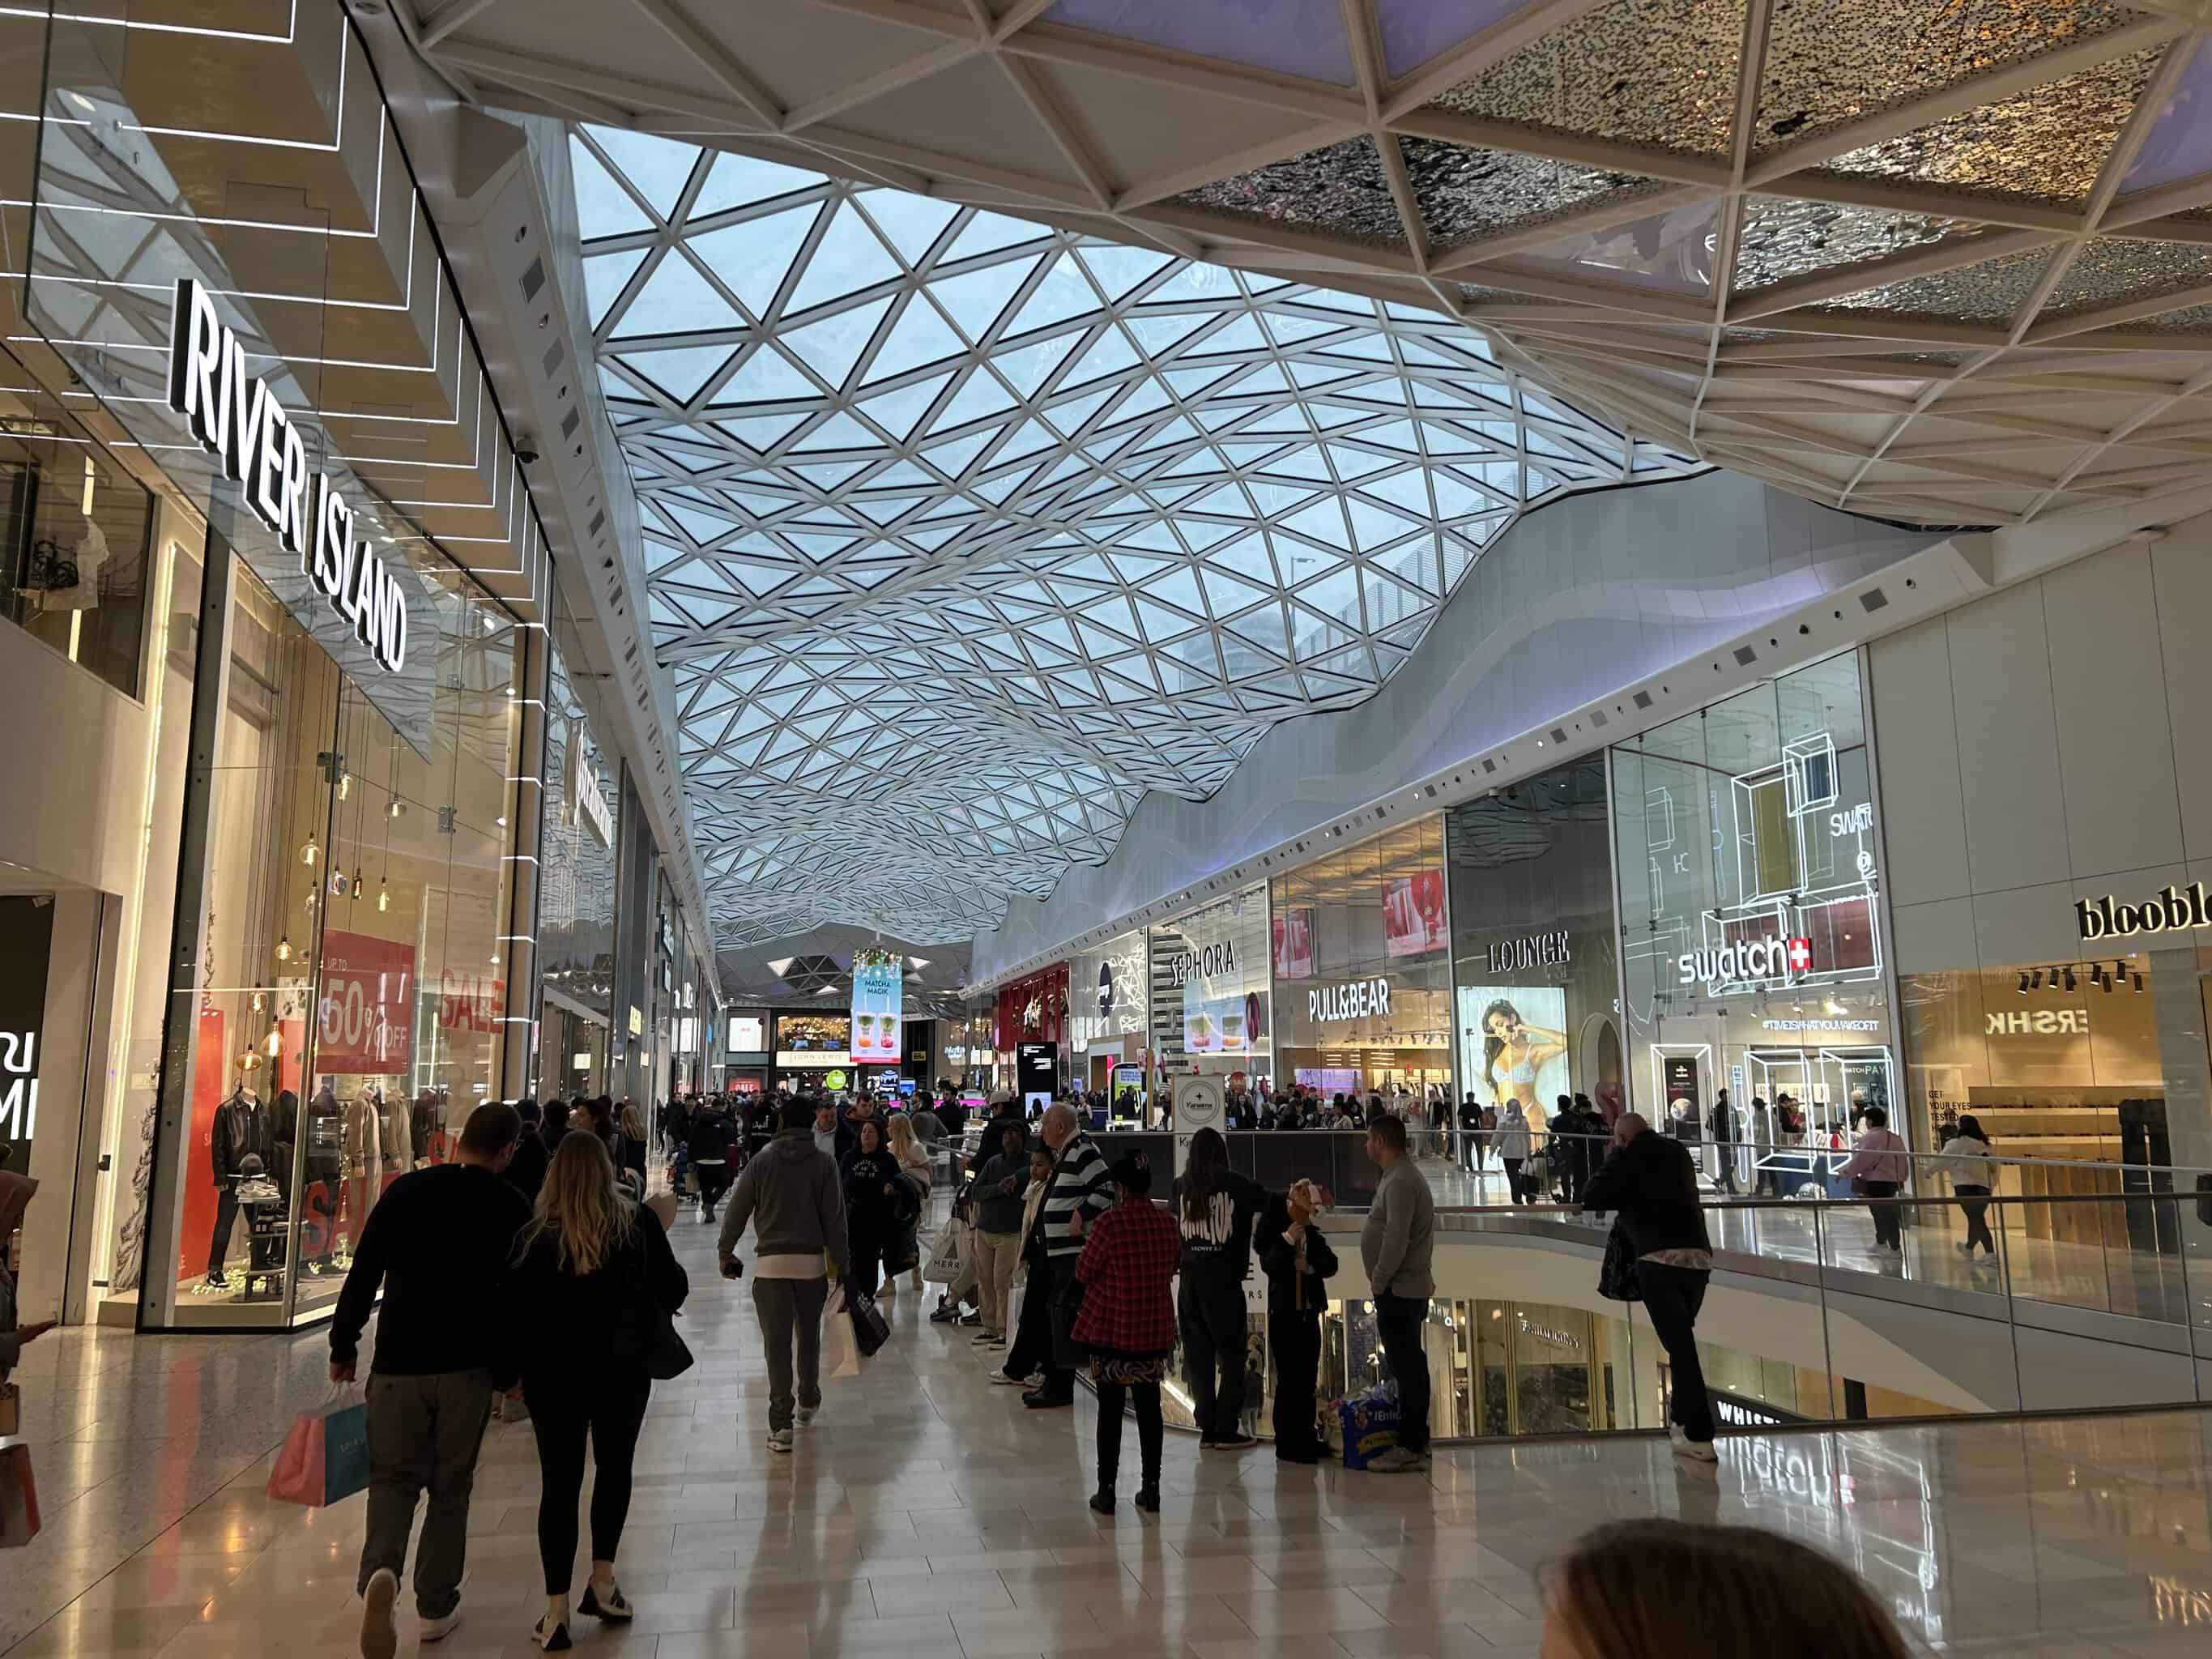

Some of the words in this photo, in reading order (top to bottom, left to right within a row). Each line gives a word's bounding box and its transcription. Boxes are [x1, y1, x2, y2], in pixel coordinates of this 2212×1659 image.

[172, 278, 308, 552] RIVER
[309, 473, 407, 672] ISLAND
[327, 958, 337, 970] UP
[339, 959, 347, 970] TO
[1170, 939, 1237, 987] SEPHORA
[1487, 929, 1570, 974] LOUNGE
[1678, 933, 1788, 984] swatch
[439, 968, 506, 1034] SALE
[867, 987, 889, 996] MAGIK
[1309, 979, 1390, 1023] PULL&BEAR
[1865, 1064, 1886, 1076] PAY
[1929, 1090, 1944, 1098] GET
[1952, 1102, 1971, 1111] EYES
[1717, 1400, 1781, 1426] WHIS
